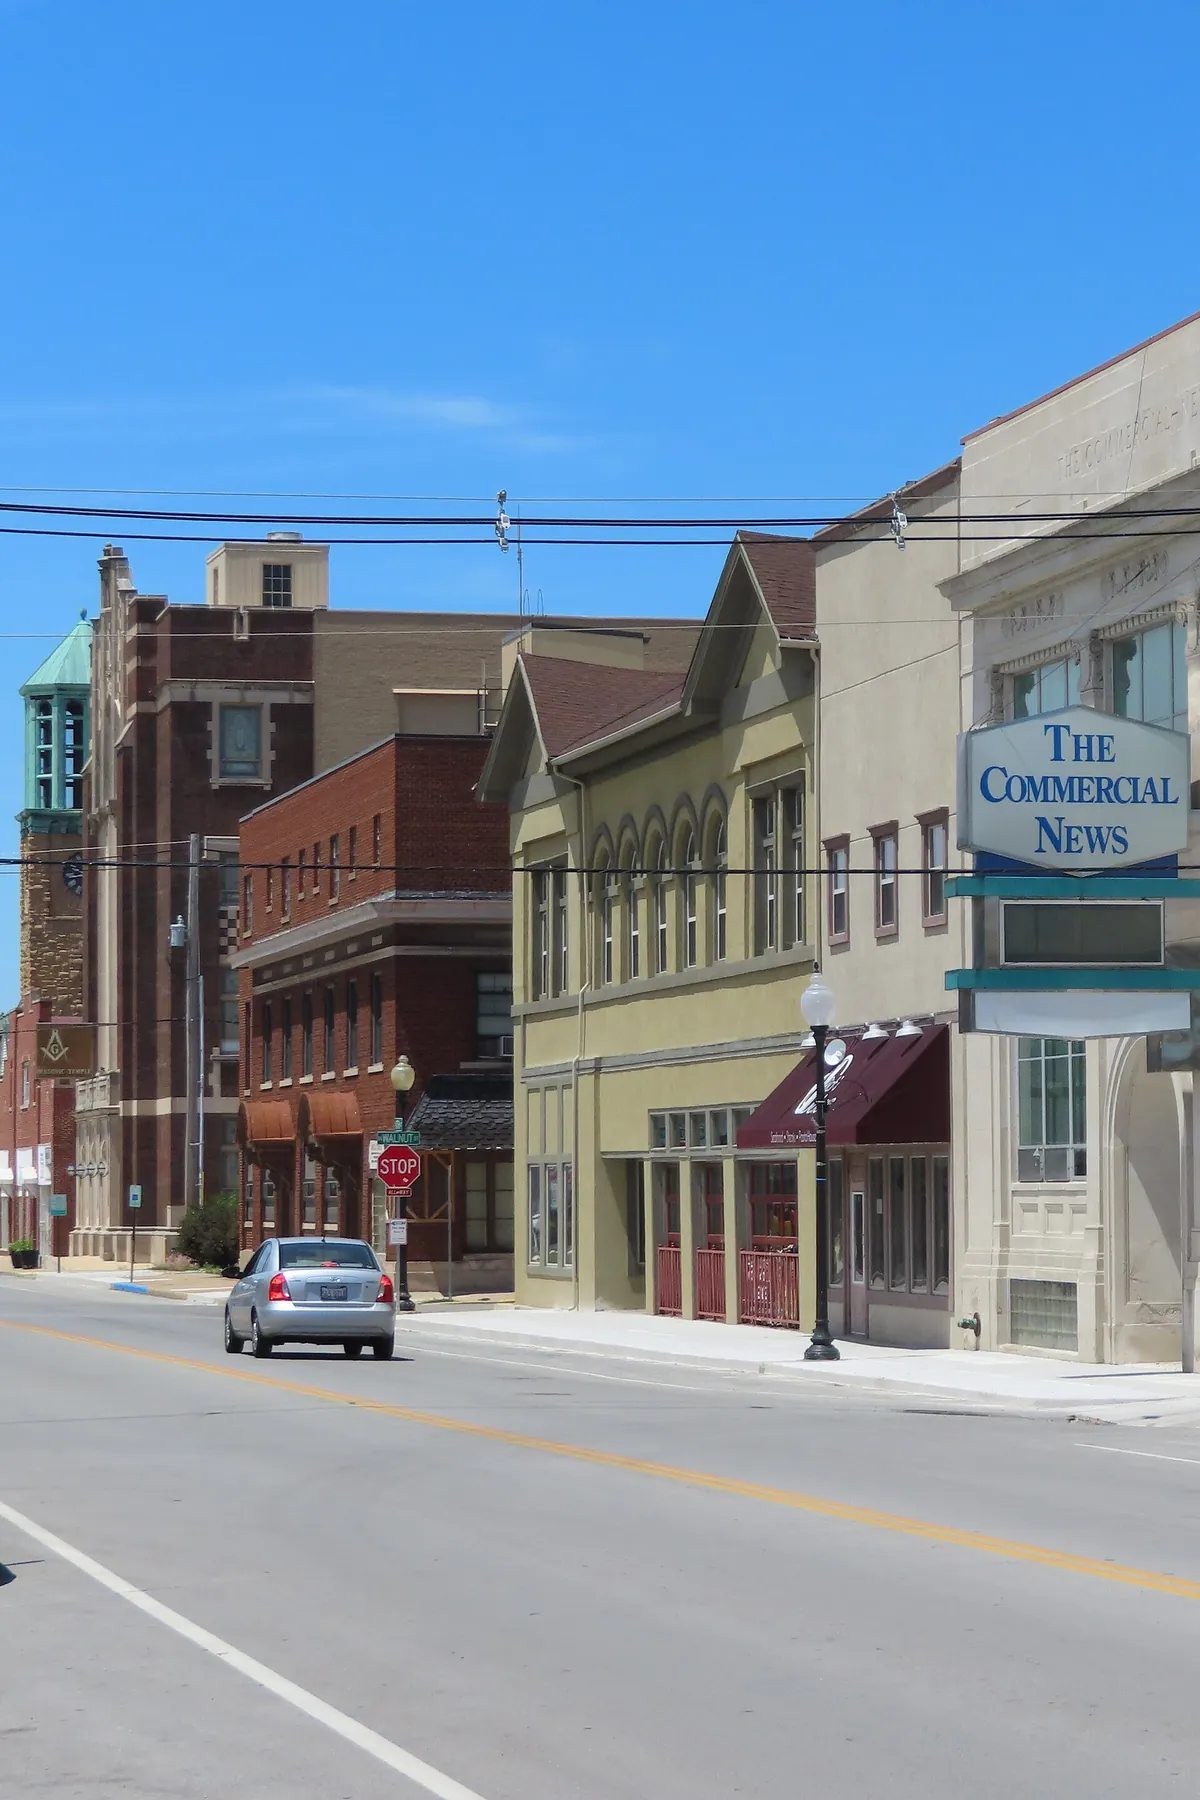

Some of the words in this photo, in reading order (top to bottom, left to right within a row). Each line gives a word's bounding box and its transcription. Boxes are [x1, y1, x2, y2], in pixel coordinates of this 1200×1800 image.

[1044, 724, 1116, 763] THE
[979, 765, 1180, 804] COMMERCIAL
[1034, 816, 1129, 855] NEWS
[382, 1133, 414, 1143] WALNUT
[380, 1158, 417, 1174] STOP
